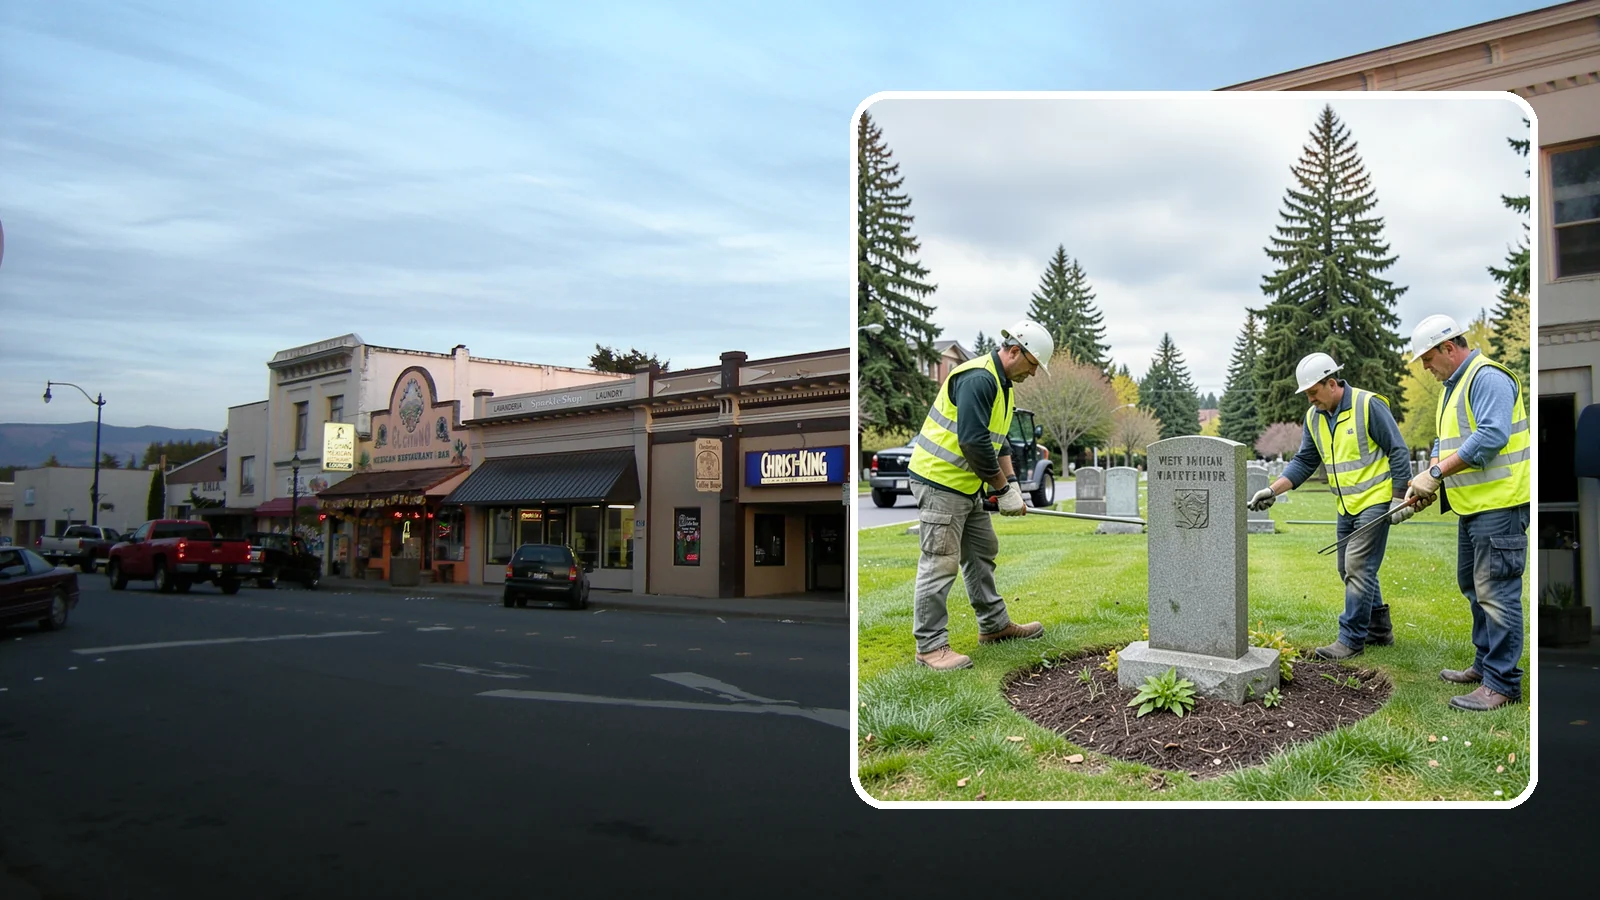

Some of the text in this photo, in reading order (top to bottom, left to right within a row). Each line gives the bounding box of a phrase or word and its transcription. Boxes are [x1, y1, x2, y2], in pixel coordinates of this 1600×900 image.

[531, 394, 583, 409] Sparkle Shop
[595, 389, 623, 400] LAUNDRY
[494, 402, 522, 412] LAVANDERIA
[373, 455, 396, 464] MEXICAN
[397, 451, 433, 462] RESTAURANT
[438, 450, 450, 459] BAR
[761, 452, 797, 478] CHRIST
[799, 450, 827, 476] KING
